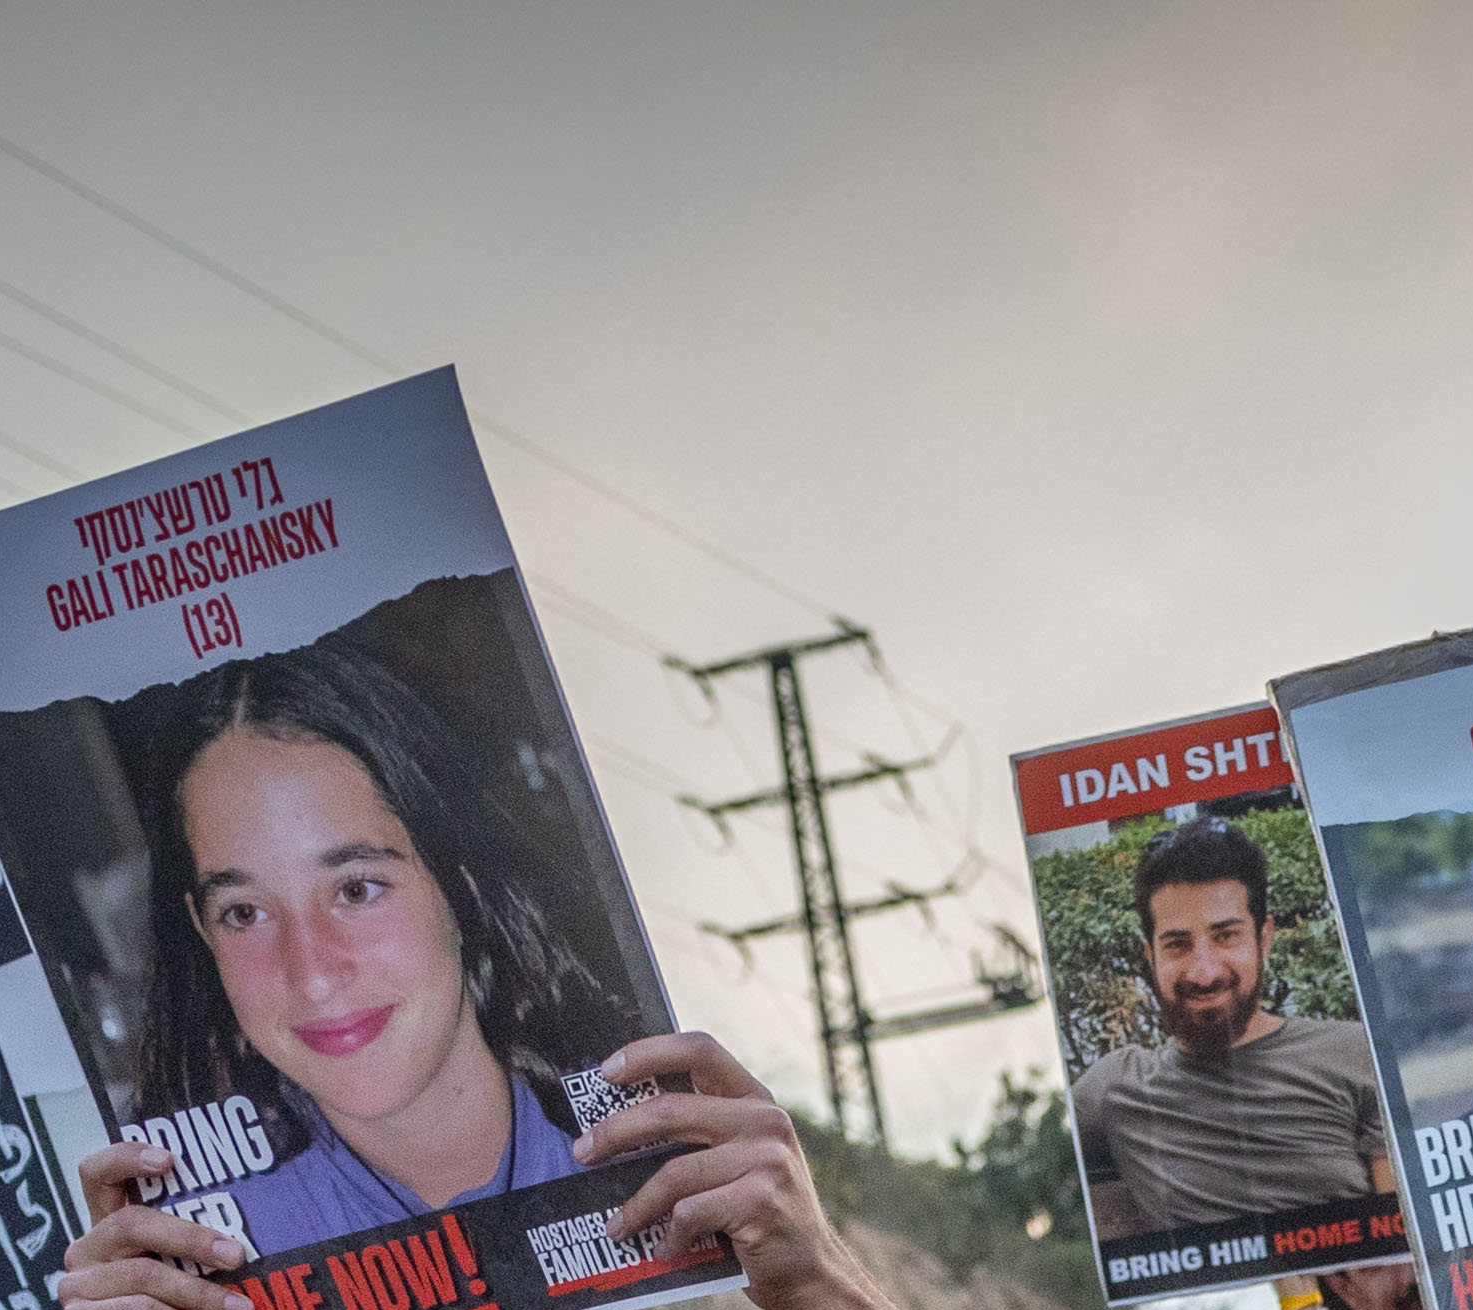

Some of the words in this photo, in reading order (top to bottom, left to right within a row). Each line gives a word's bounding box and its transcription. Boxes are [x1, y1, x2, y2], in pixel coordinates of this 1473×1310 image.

[232, 456, 285, 511] גלי
[45, 570, 116, 632] GALI
[112, 498, 340, 611] TARASCHANSKY
[181, 592, 244, 660] (13)
[1058, 753, 1171, 808] IDAN
[526, 1211, 607, 1254] HOSTAGES
[1107, 1245, 1204, 1284] BRING
[1209, 1233, 1268, 1269] HIM
[1273, 1218, 1364, 1255] HOME
[536, 1235, 642, 1287] FAMILIES
